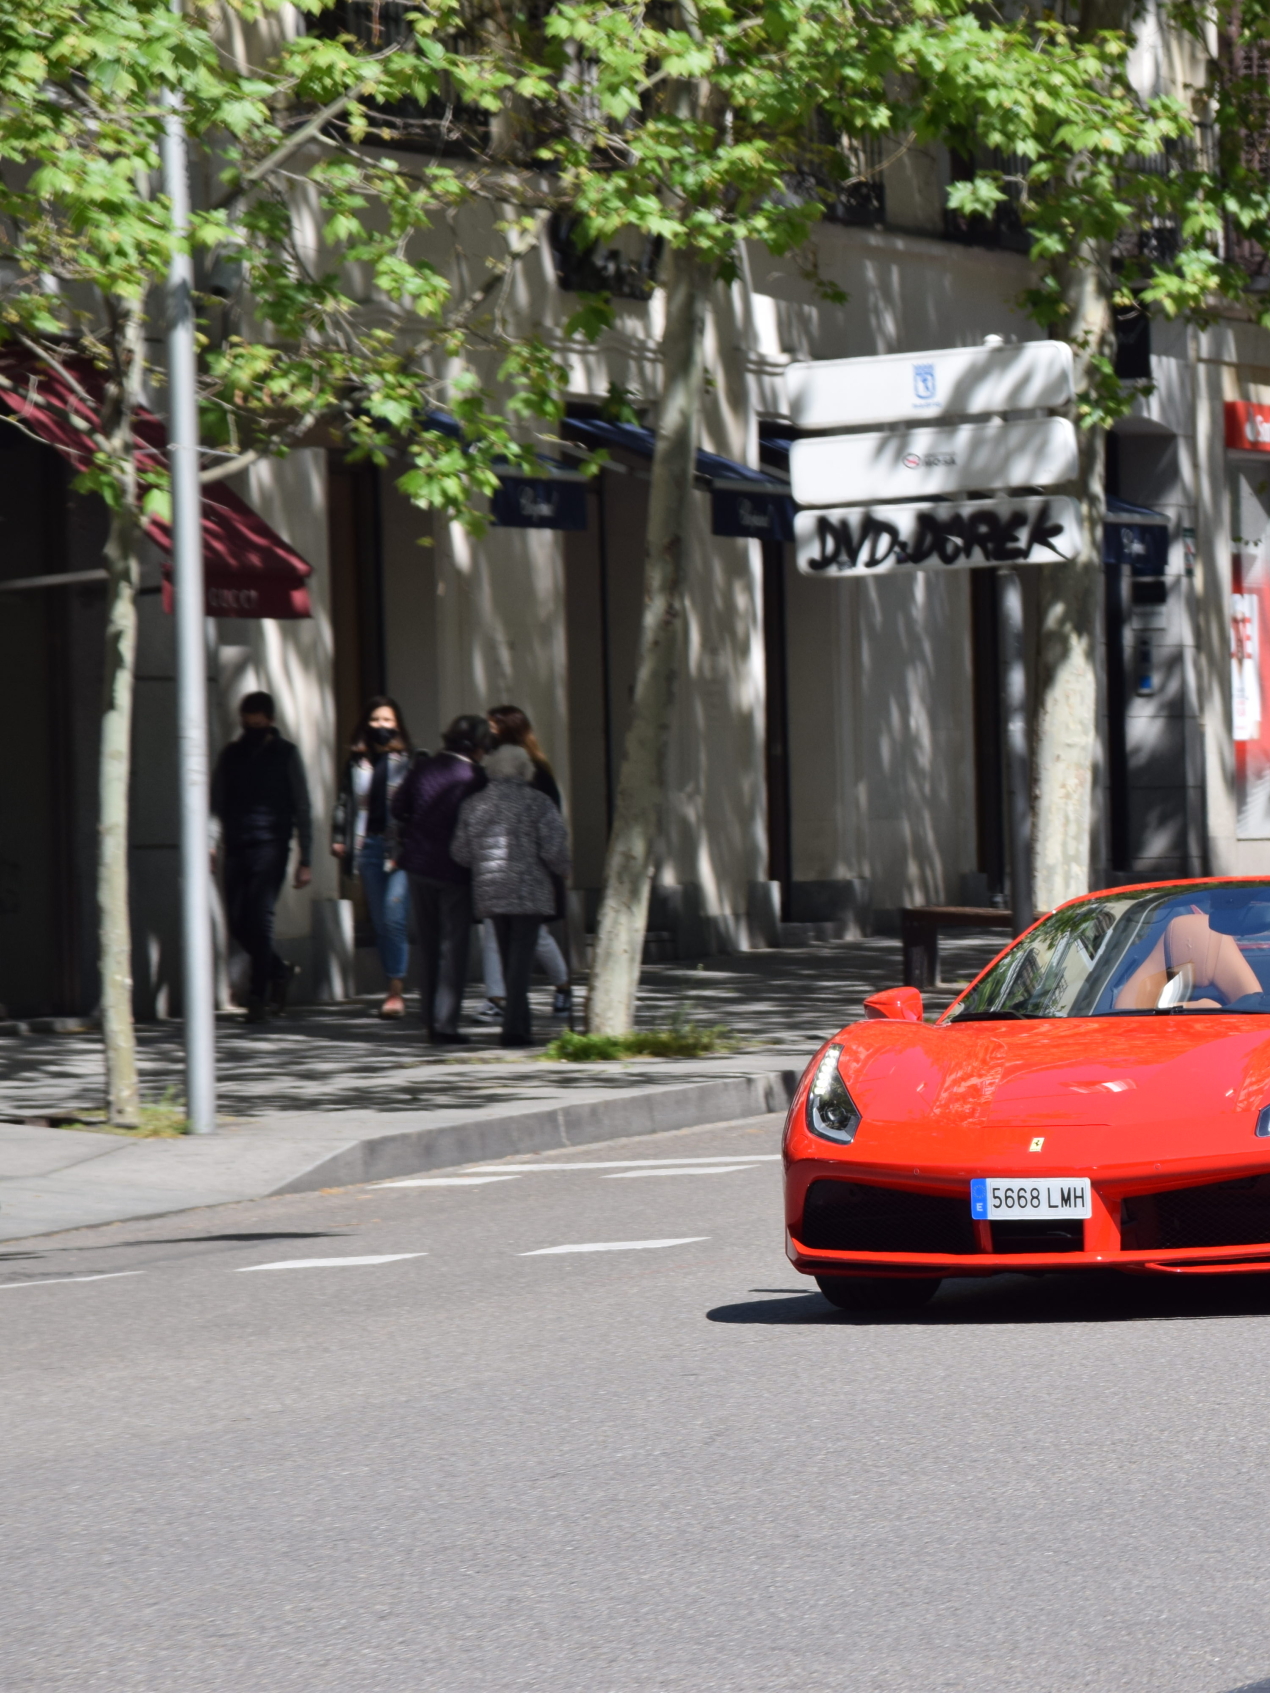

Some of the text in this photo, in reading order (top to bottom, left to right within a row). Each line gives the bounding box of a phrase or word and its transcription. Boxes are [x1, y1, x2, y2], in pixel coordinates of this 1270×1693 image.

[976, 1187, 1085, 1211] E 5668 LMH
